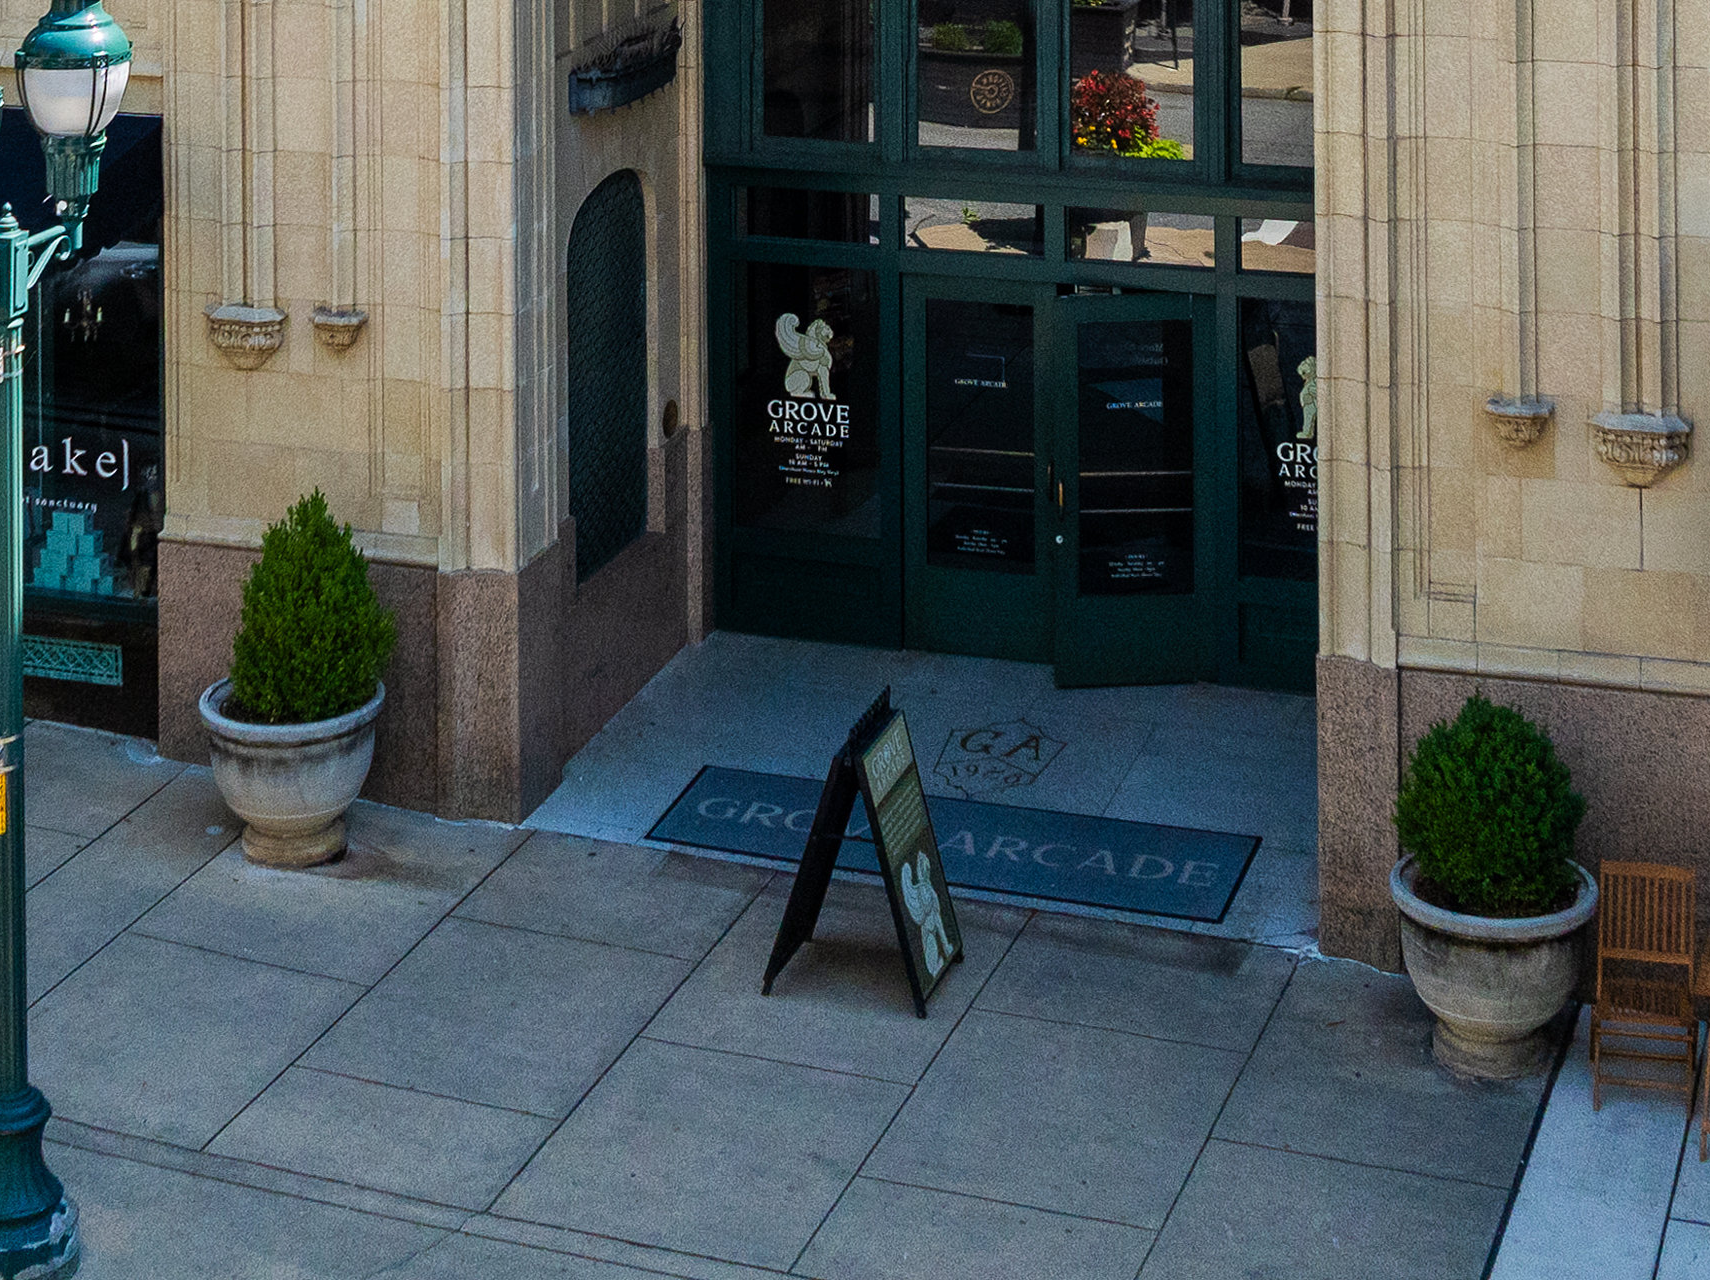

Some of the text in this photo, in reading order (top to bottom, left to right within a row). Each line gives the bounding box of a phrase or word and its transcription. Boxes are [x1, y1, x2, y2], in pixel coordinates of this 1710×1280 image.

[767, 400, 850, 424] GROVE
[769, 420, 850, 438] ARCADE
[774, 436, 843, 447] MONDAY SATURDAY
[795, 453, 822, 461] SUNDAY
[1284, 480, 1316, 488] MONDAY
[35, 497, 98, 514] sanctuary
[941, 830, 1221, 888] ARCADE
